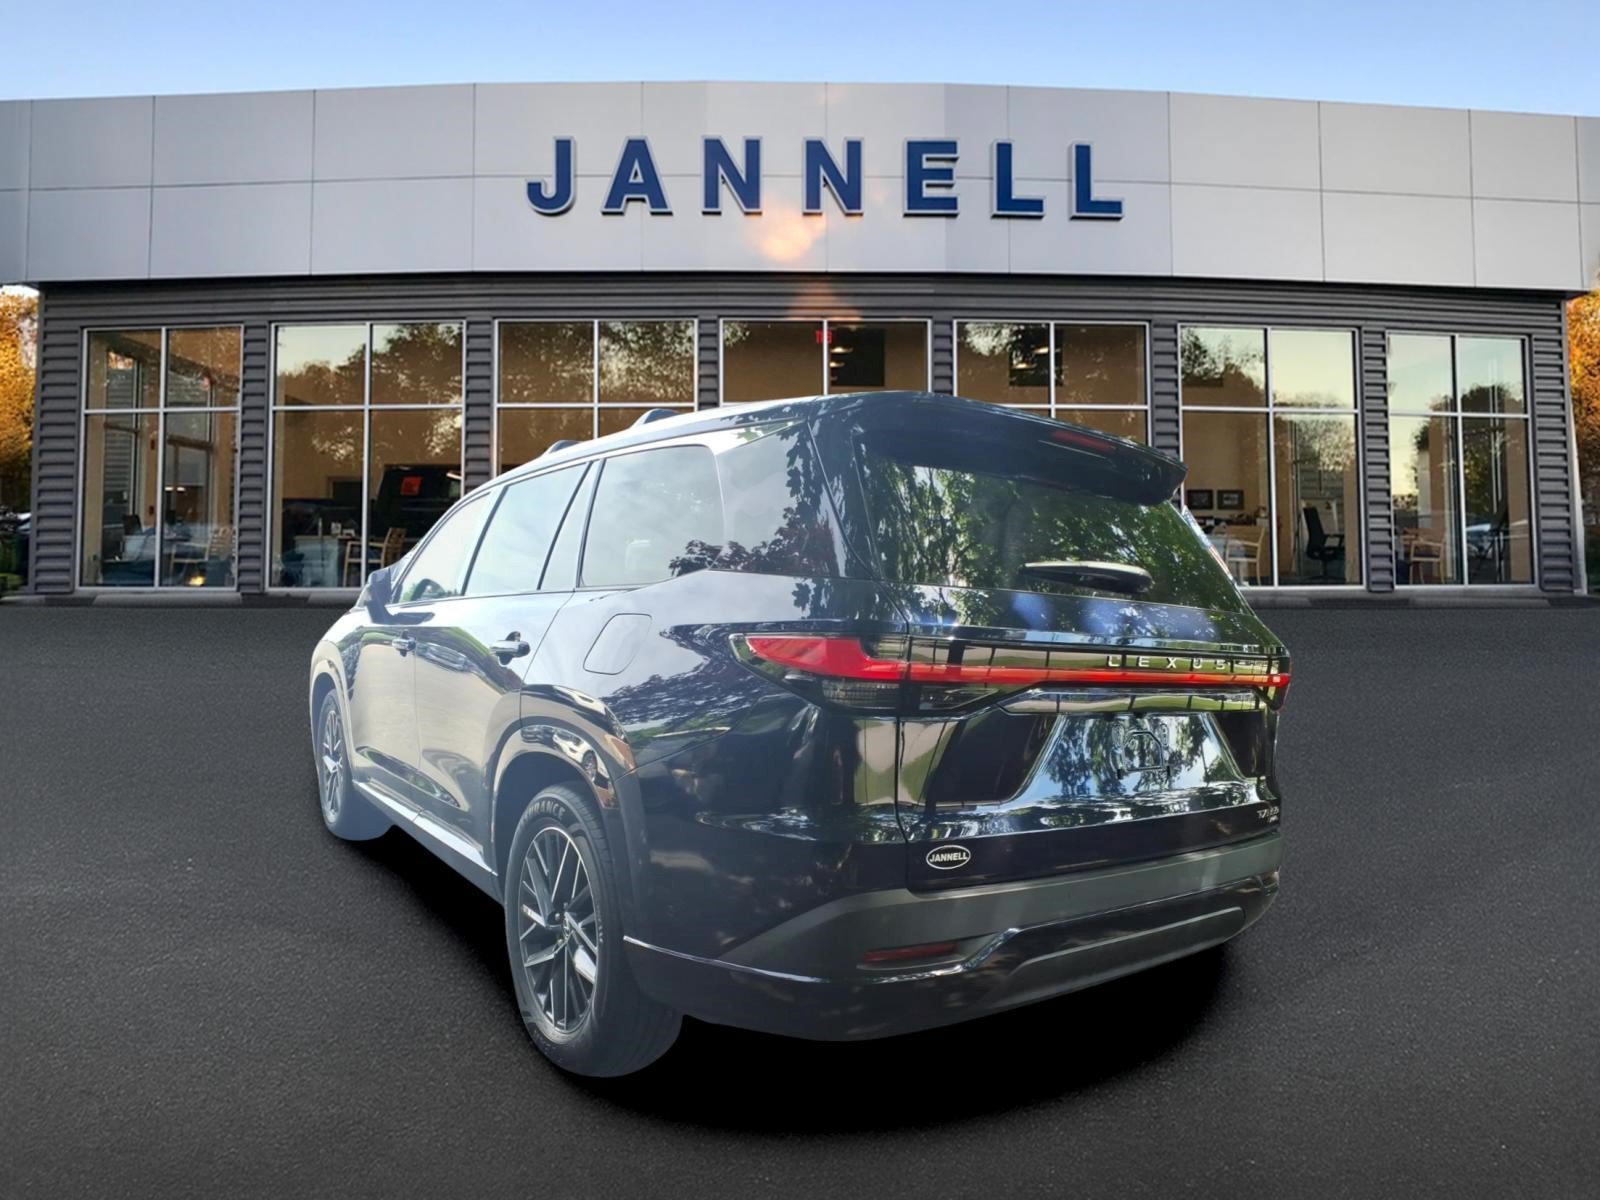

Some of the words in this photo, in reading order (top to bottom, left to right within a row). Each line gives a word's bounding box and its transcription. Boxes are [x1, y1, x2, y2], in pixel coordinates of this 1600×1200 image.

[526, 136, 1124, 218] JANNELL
[1108, 655, 1226, 670] LEXUS
[930, 852, 968, 862] JANNELL
